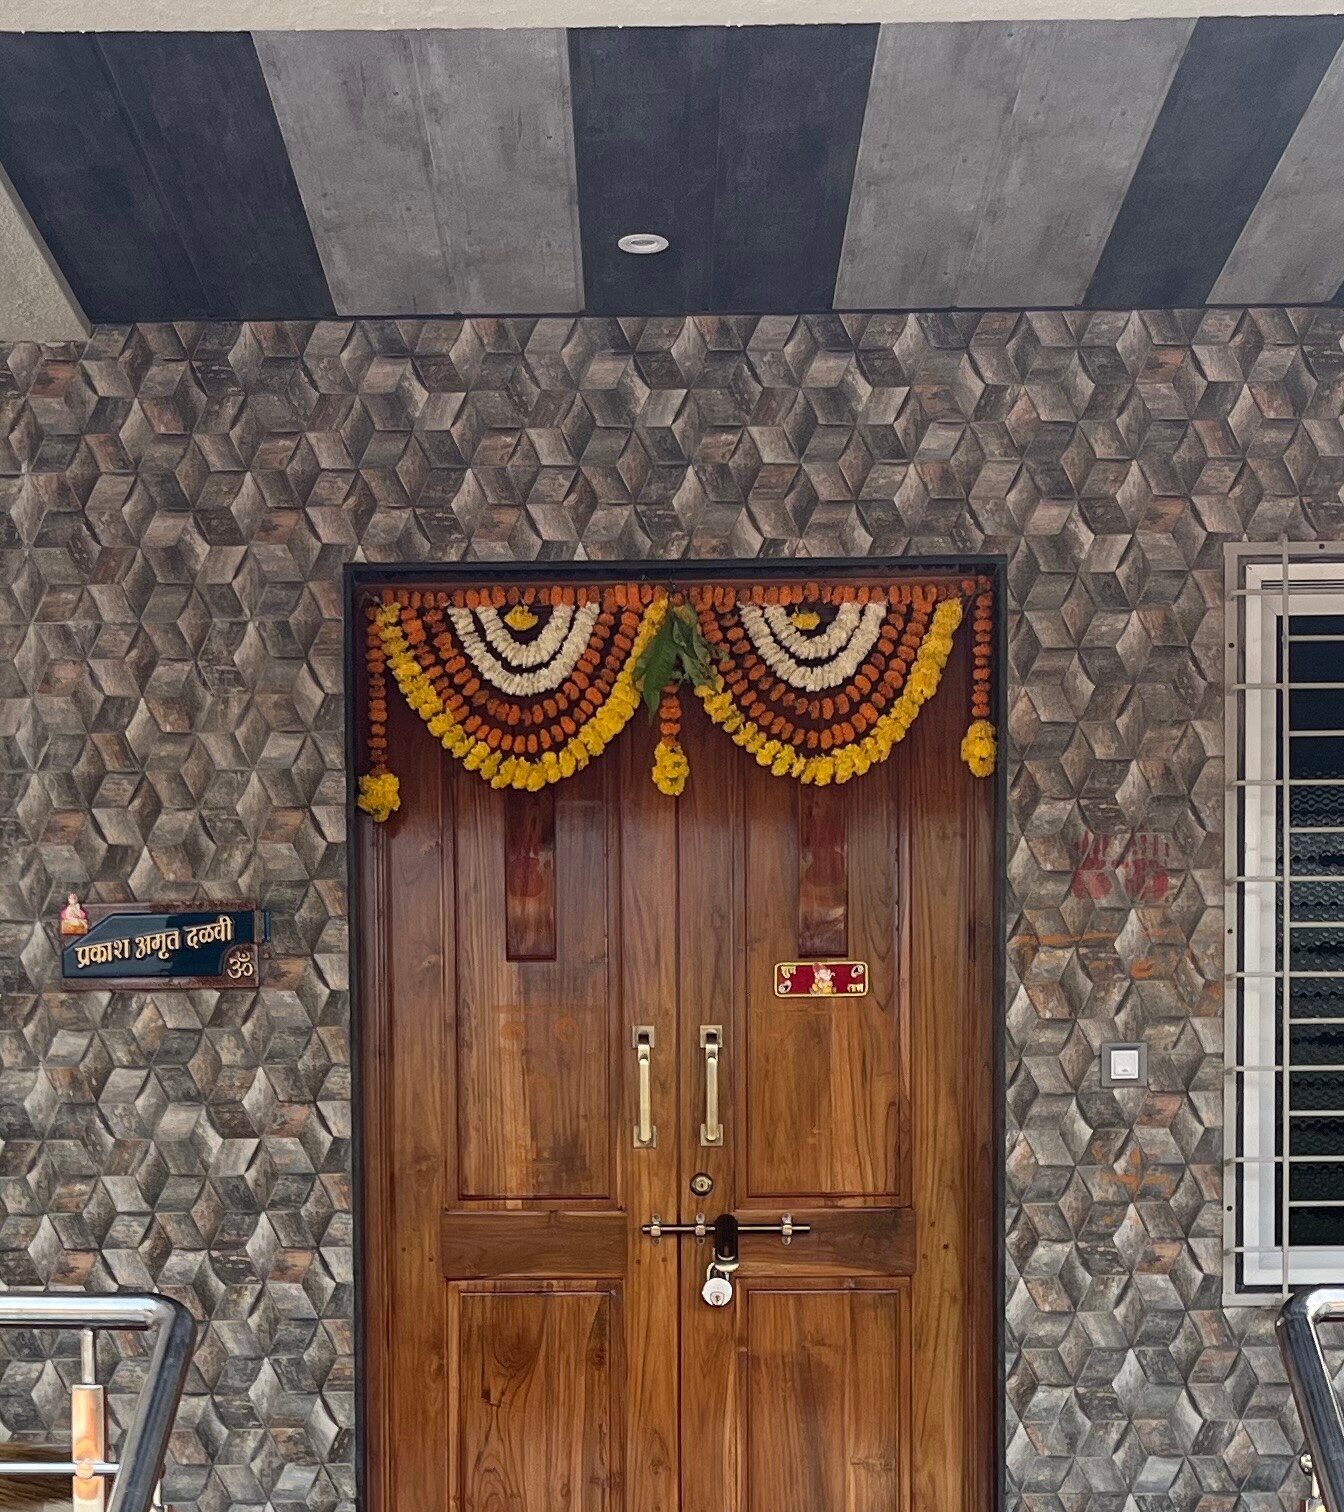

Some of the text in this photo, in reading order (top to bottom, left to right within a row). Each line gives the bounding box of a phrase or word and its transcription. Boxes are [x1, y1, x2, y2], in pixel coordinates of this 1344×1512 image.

[75, 915, 233, 968] प्रकाश अमृत दळवी
